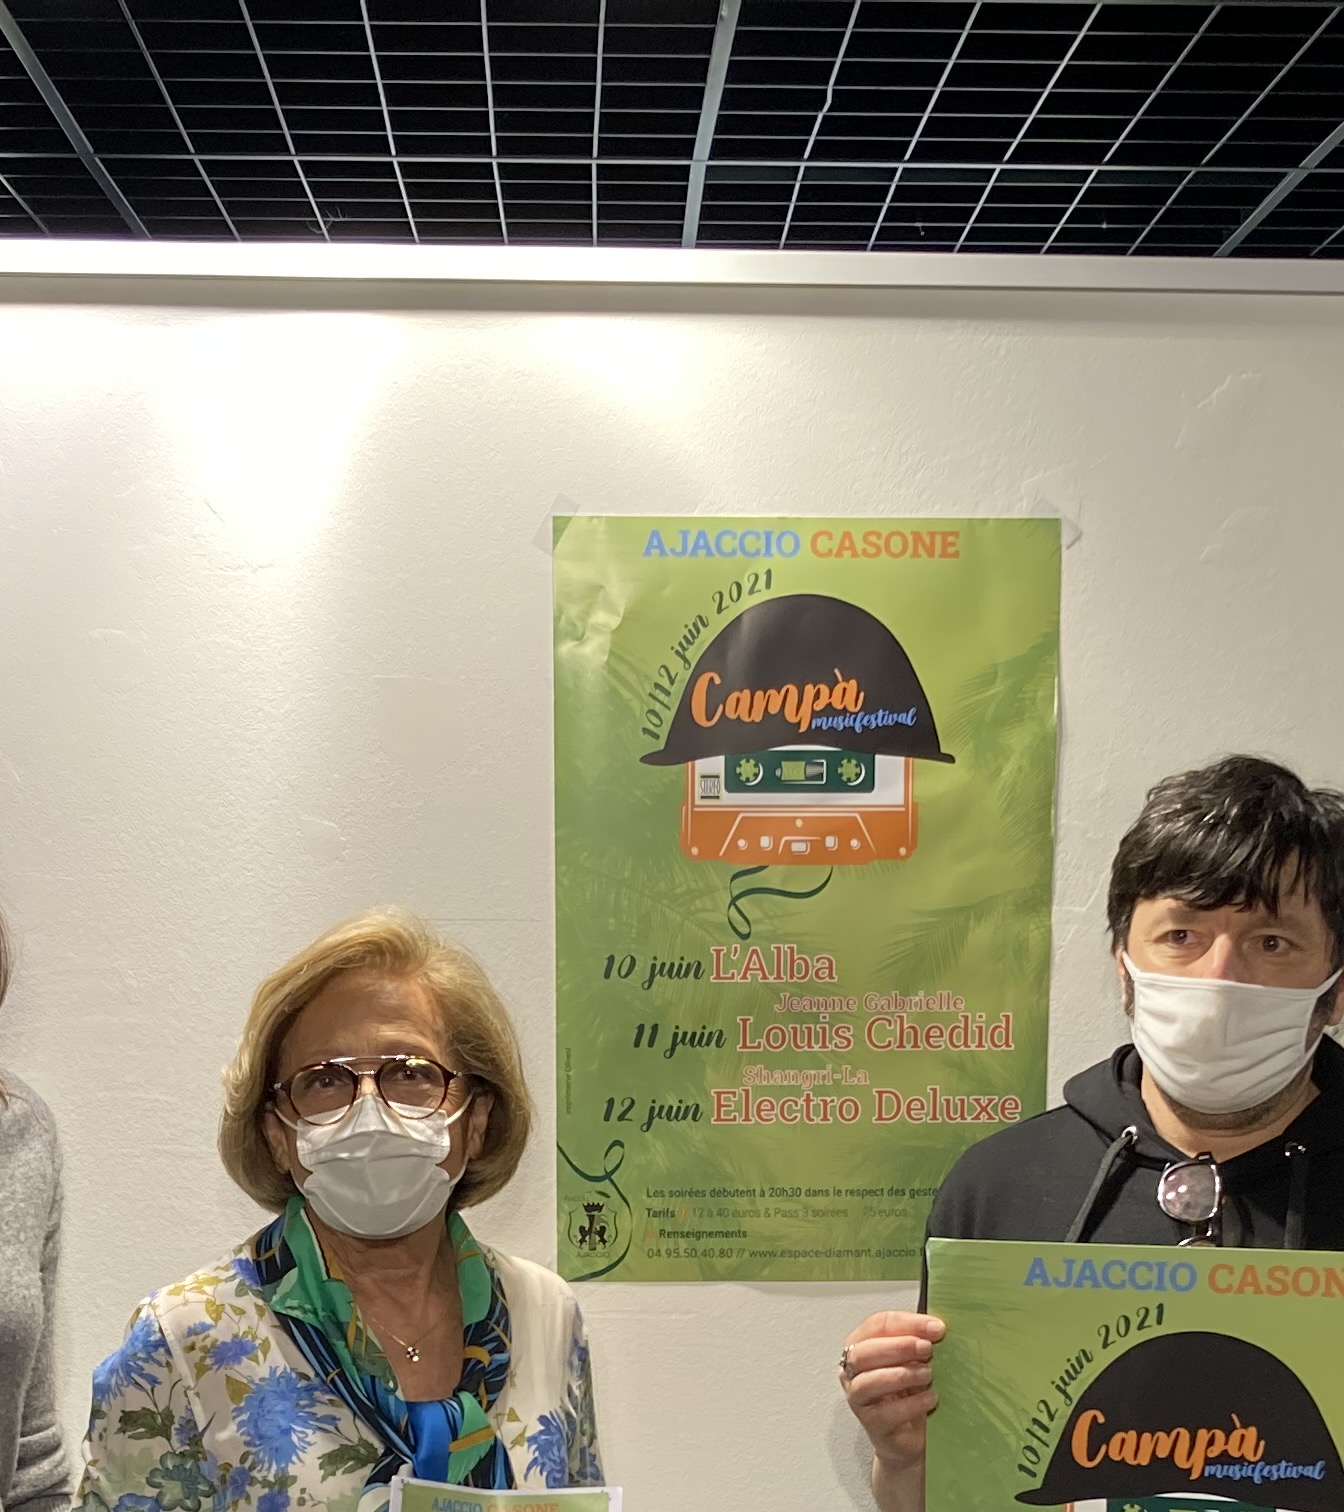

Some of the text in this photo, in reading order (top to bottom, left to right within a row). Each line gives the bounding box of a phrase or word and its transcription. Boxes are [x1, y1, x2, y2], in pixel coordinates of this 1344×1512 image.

[642, 529, 960, 559] AJACCIO CASONE
[669, 614, 709, 671] juin
[711, 568, 773, 615] 2021
[690, 667, 865, 733] Campà
[811, 707, 916, 734] musicfestival
[603, 954, 636, 980] 10
[641, 956, 705, 990] juin
[775, 991, 965, 1012] Jeanne Gabrielle
[633, 1012, 1015, 1059] 11 juin Louis Chedid
[742, 1065, 870, 1089] Shangri-La
[603, 1086, 1022, 1133] 12 juin Electro Deluxe
[646, 1188, 662, 1198] Les
[668, 1187, 707, 1198] soirées
[768, 1187, 802, 1198] 20h30
[805, 1187, 830, 1198] dans
[833, 1187, 843, 1198] le
[846, 1187, 885, 1199] respect
[887, 1186, 906, 1197] des
[645, 1207, 676, 1218] Tarifs
[659, 1229, 747, 1241] Renseignements
[1023, 1256, 1197, 1292] AJACCIO
[1050, 1348, 1094, 1407] juin
[1096, 1302, 1165, 1350] 2021
[1071, 1409, 1265, 1480] Campà
[1203, 1460, 1326, 1484] musicfestival
